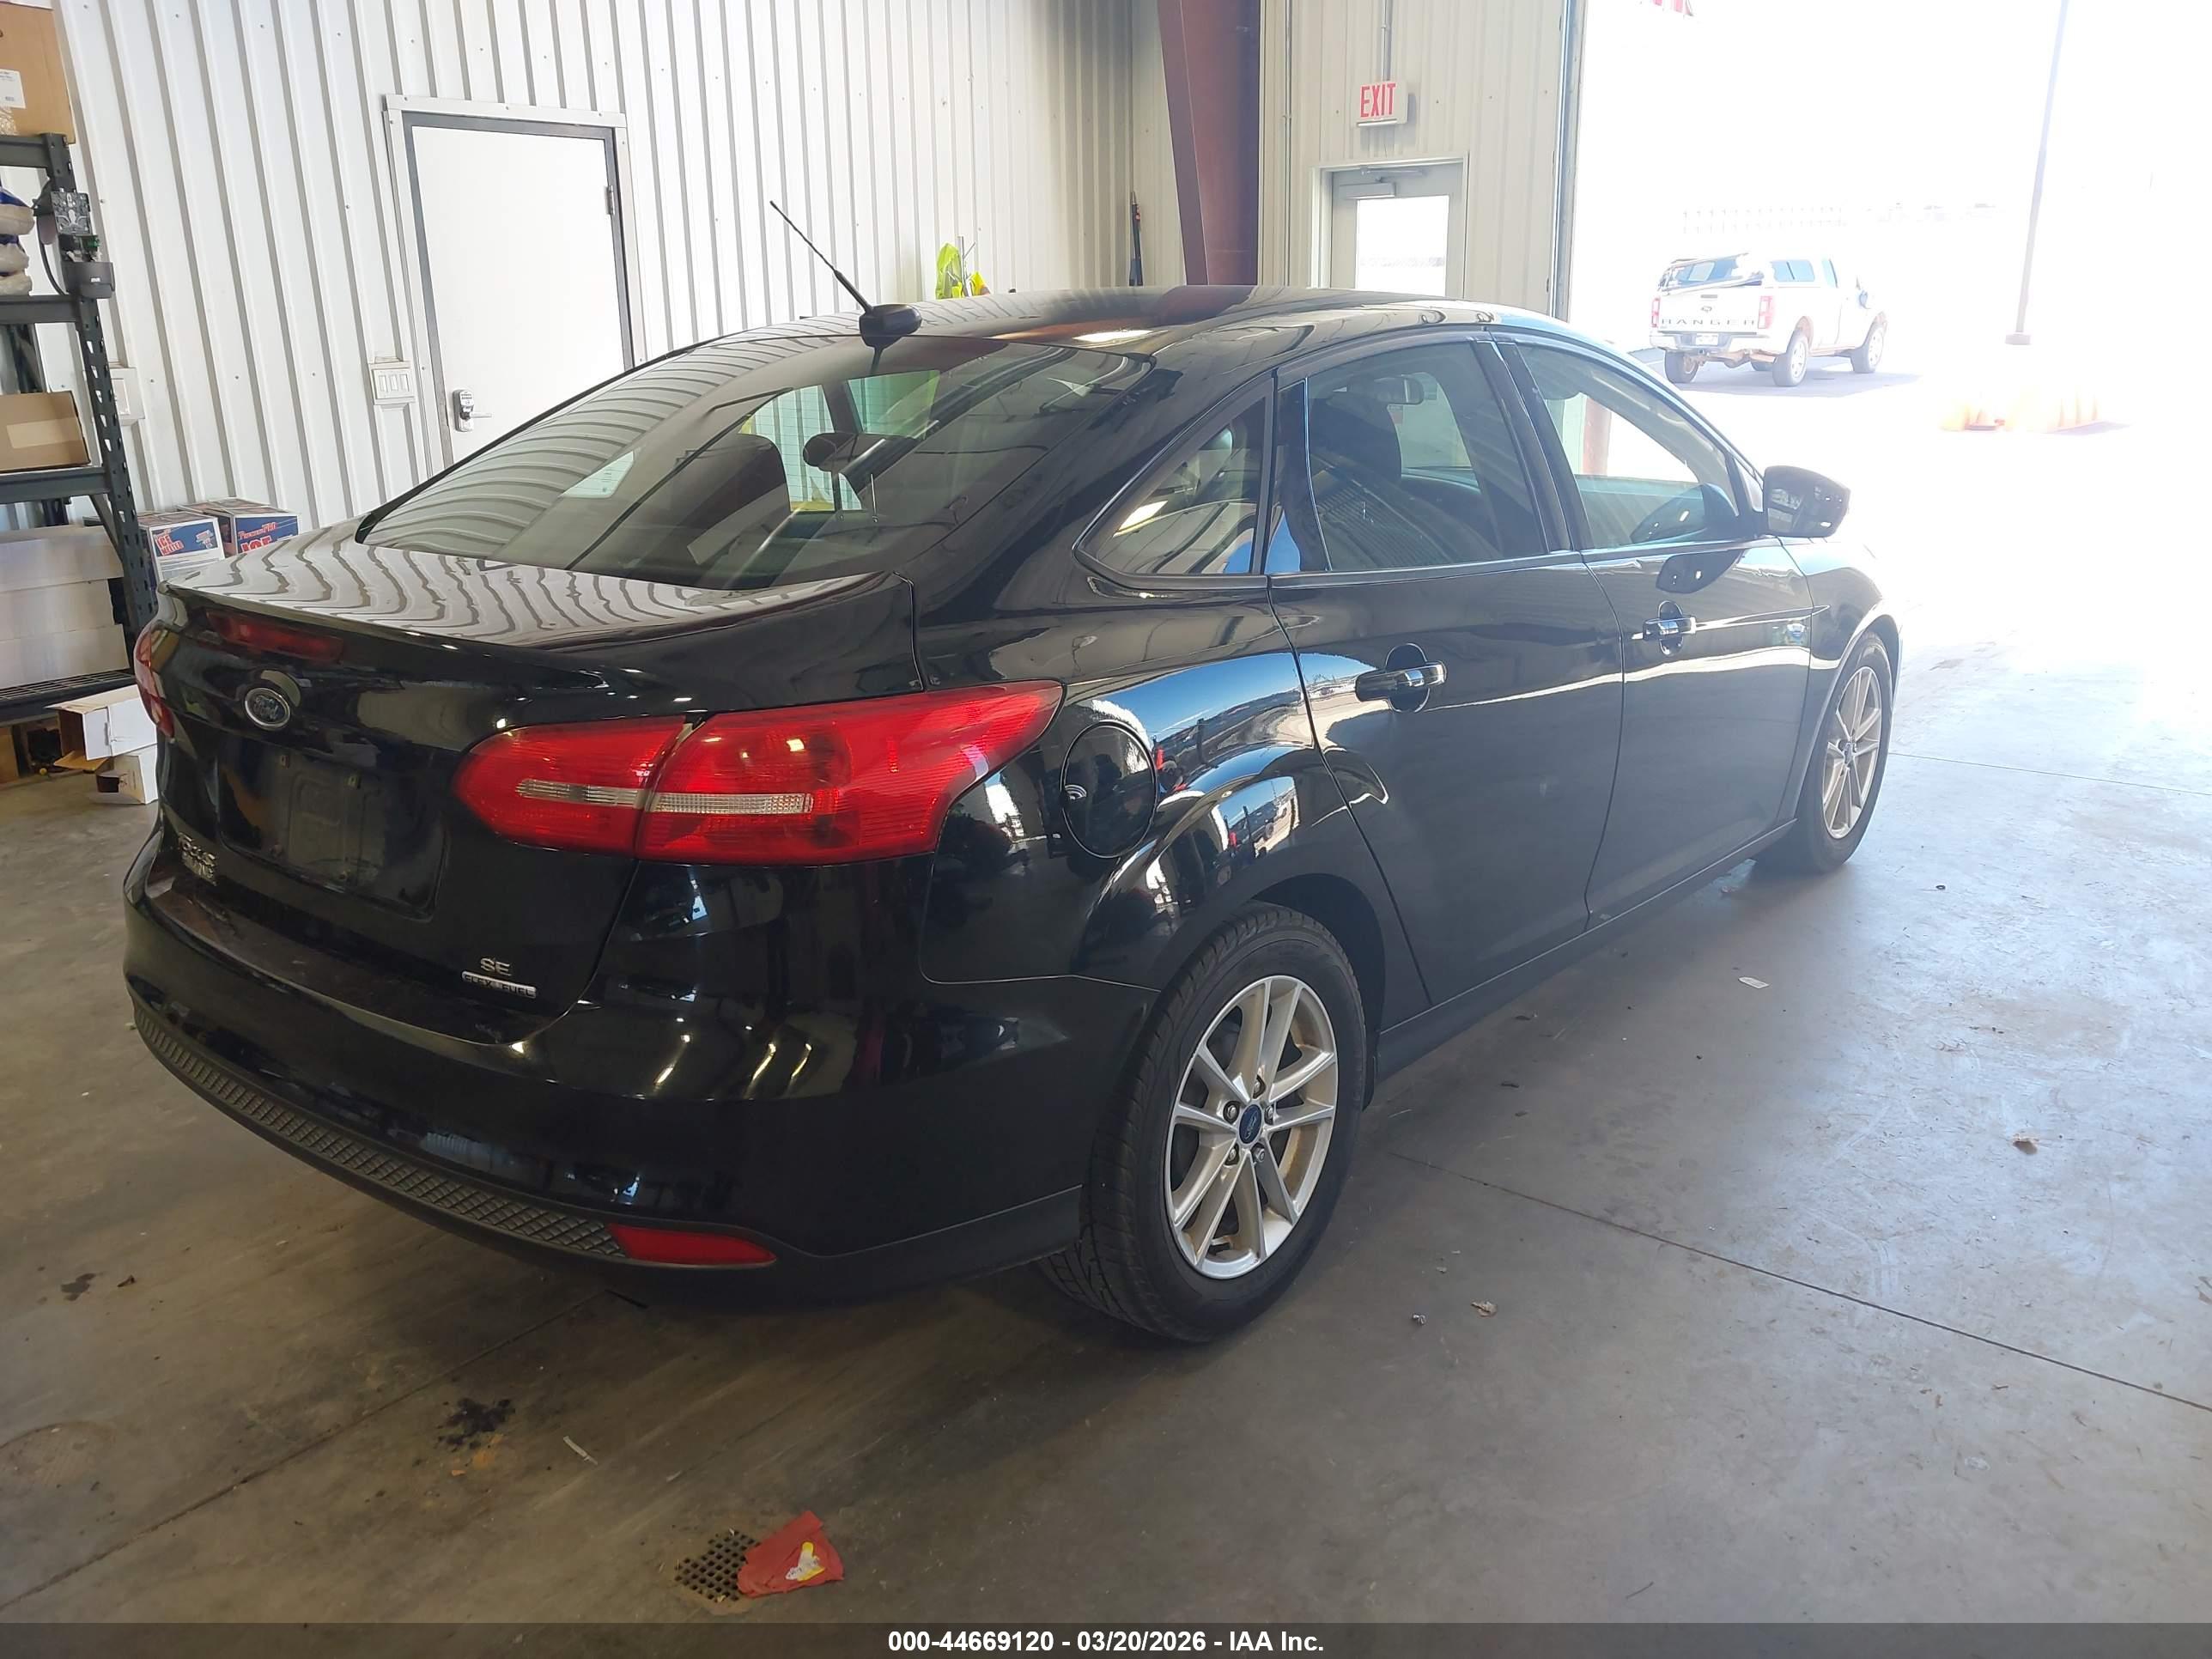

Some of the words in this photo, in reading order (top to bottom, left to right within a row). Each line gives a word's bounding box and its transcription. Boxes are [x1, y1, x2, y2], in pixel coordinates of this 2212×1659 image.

[1359, 82, 1396, 118] EXIT
[155, 533, 173, 549] ICE
[480, 957, 512, 976] SE
